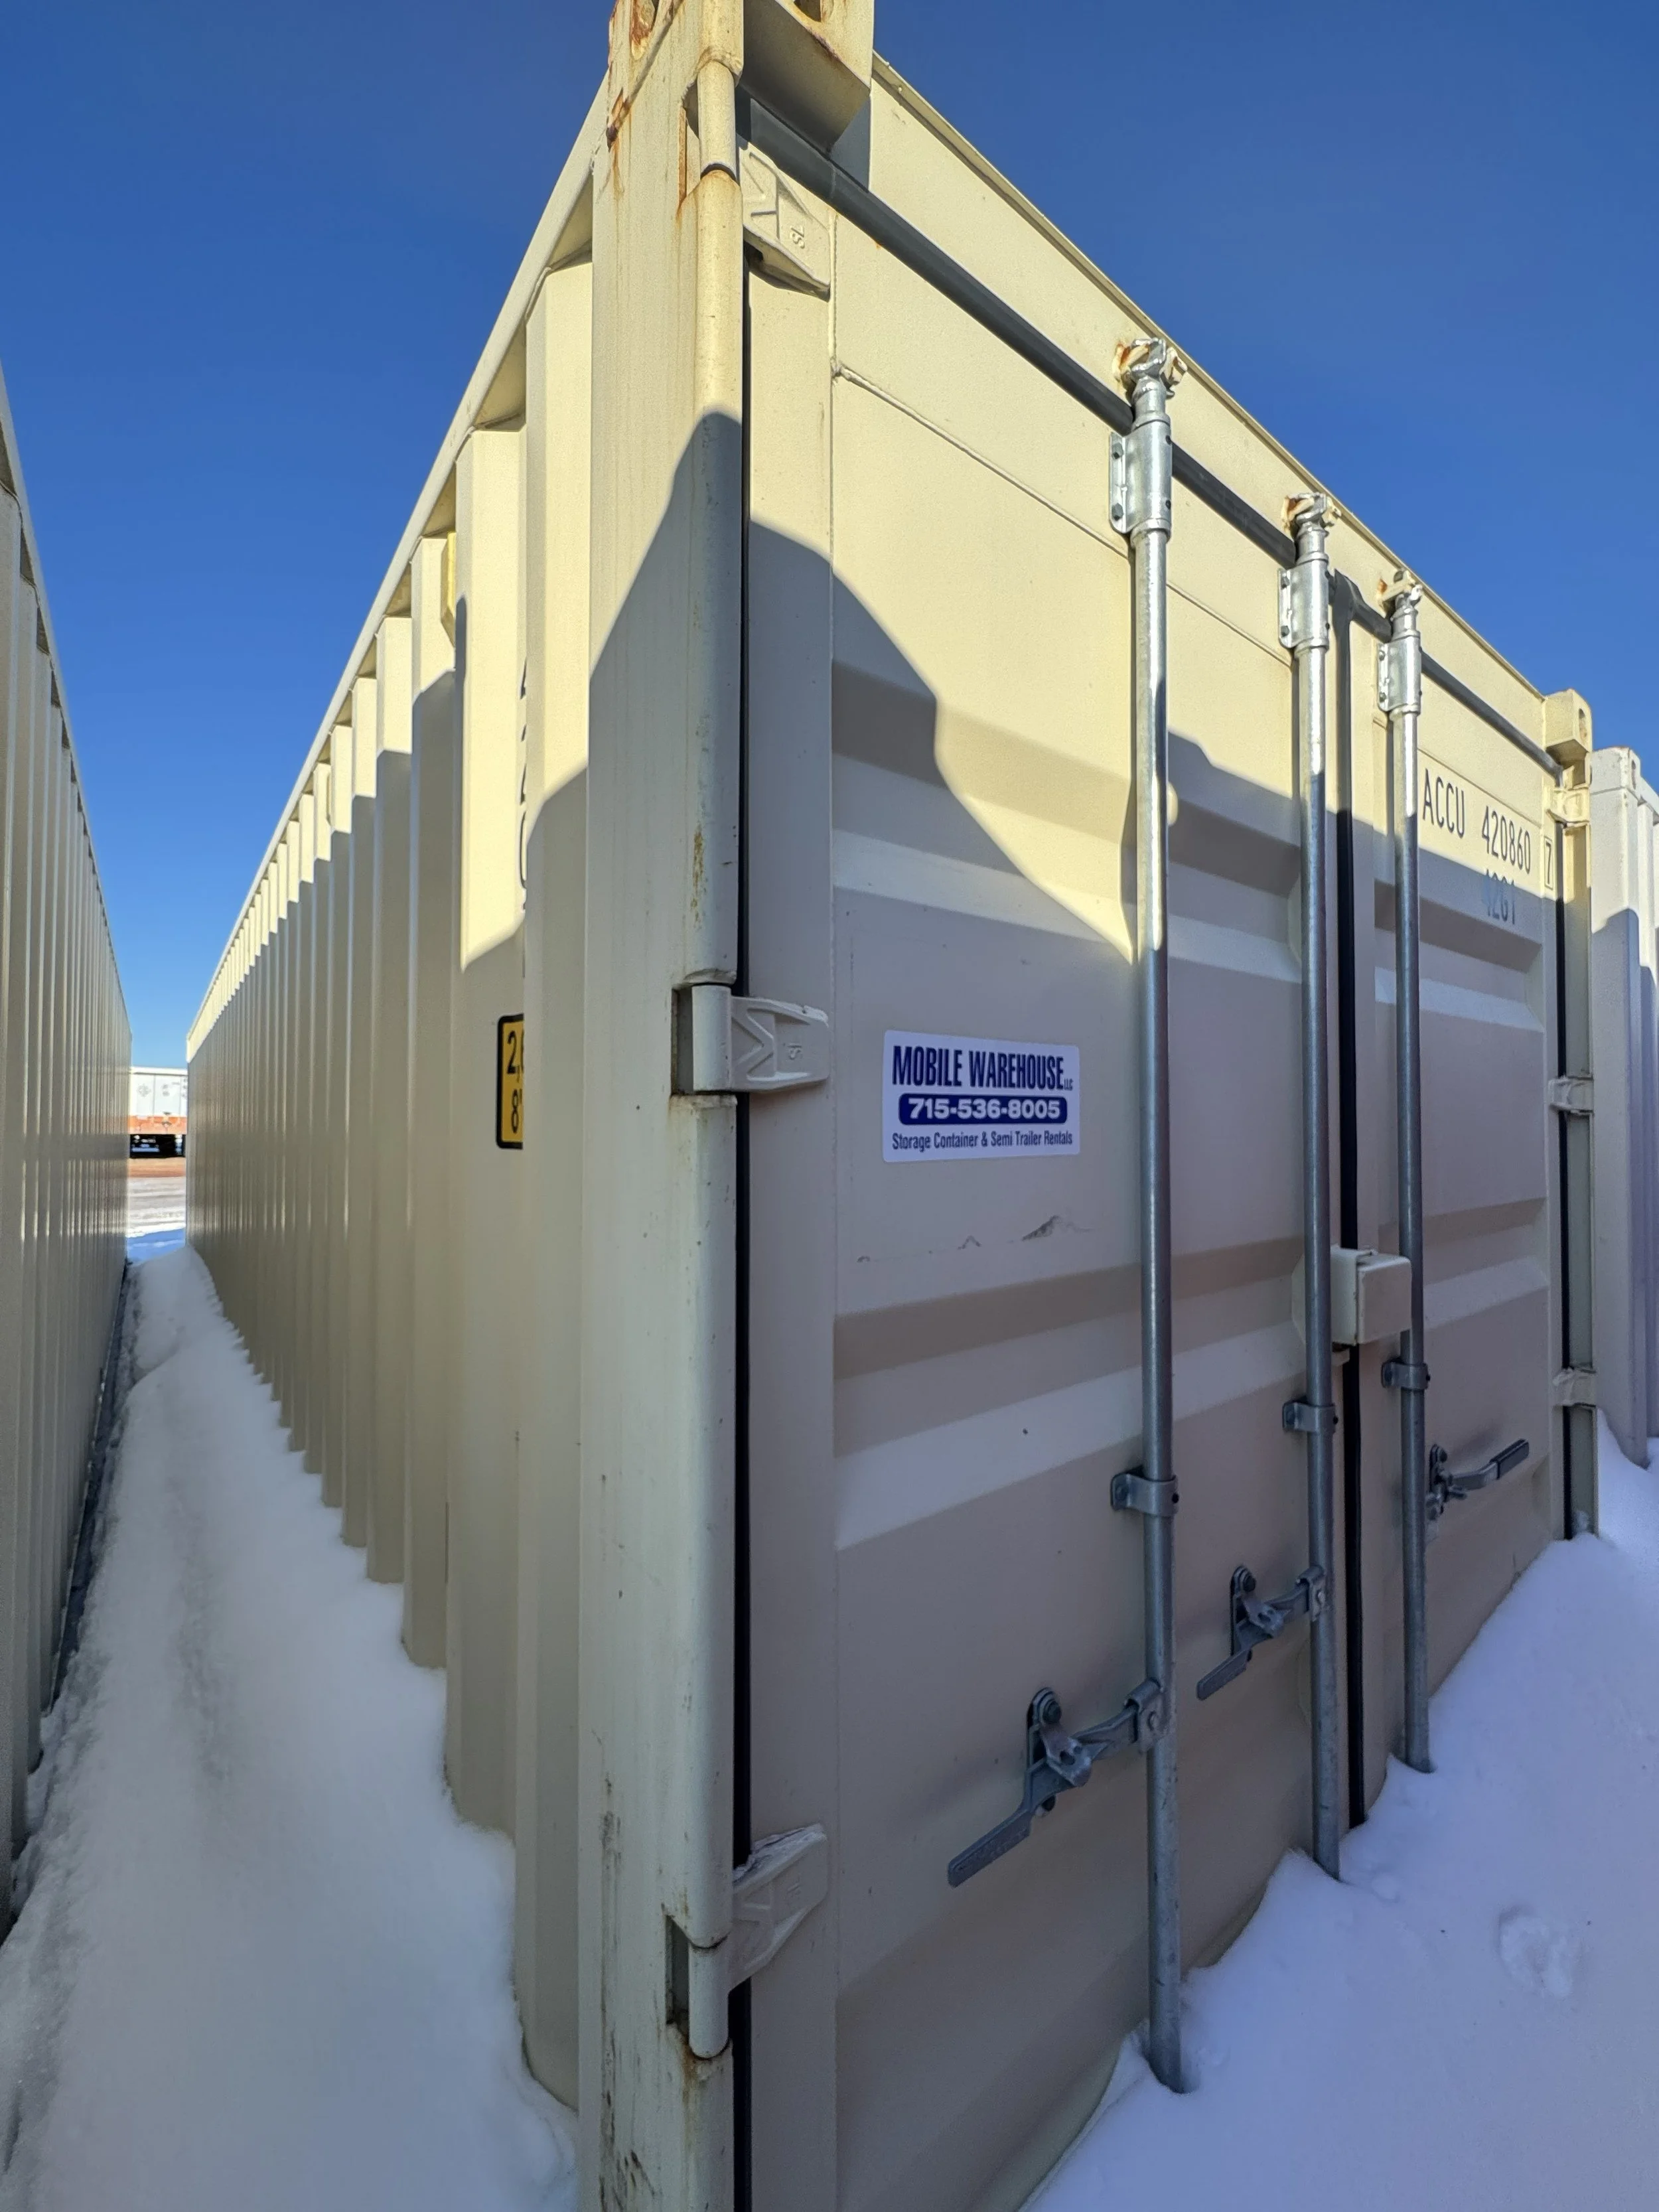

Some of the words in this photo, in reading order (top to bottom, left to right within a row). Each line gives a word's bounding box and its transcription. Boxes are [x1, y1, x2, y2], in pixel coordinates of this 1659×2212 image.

[1423, 768, 1465, 838] ACCU
[1481, 805, 1531, 875] 420860
[1546, 842, 1552, 885] 7
[892, 1045, 962, 1087] MOBILE
[968, 1050, 1064, 1090] WAREHOUSE
[1064, 1078, 1074, 1091] LLC
[908, 1097, 1060, 1120] 715-536-8005
[892, 1132, 930, 1153] Storage
[934, 1130, 978, 1149] Container
[981, 1134, 988, 1147] &
[991, 1129, 1013, 1147] Semi
[1015, 1130, 1042, 1146] Trailer
[1044, 1130, 1073, 1145] Rentals
